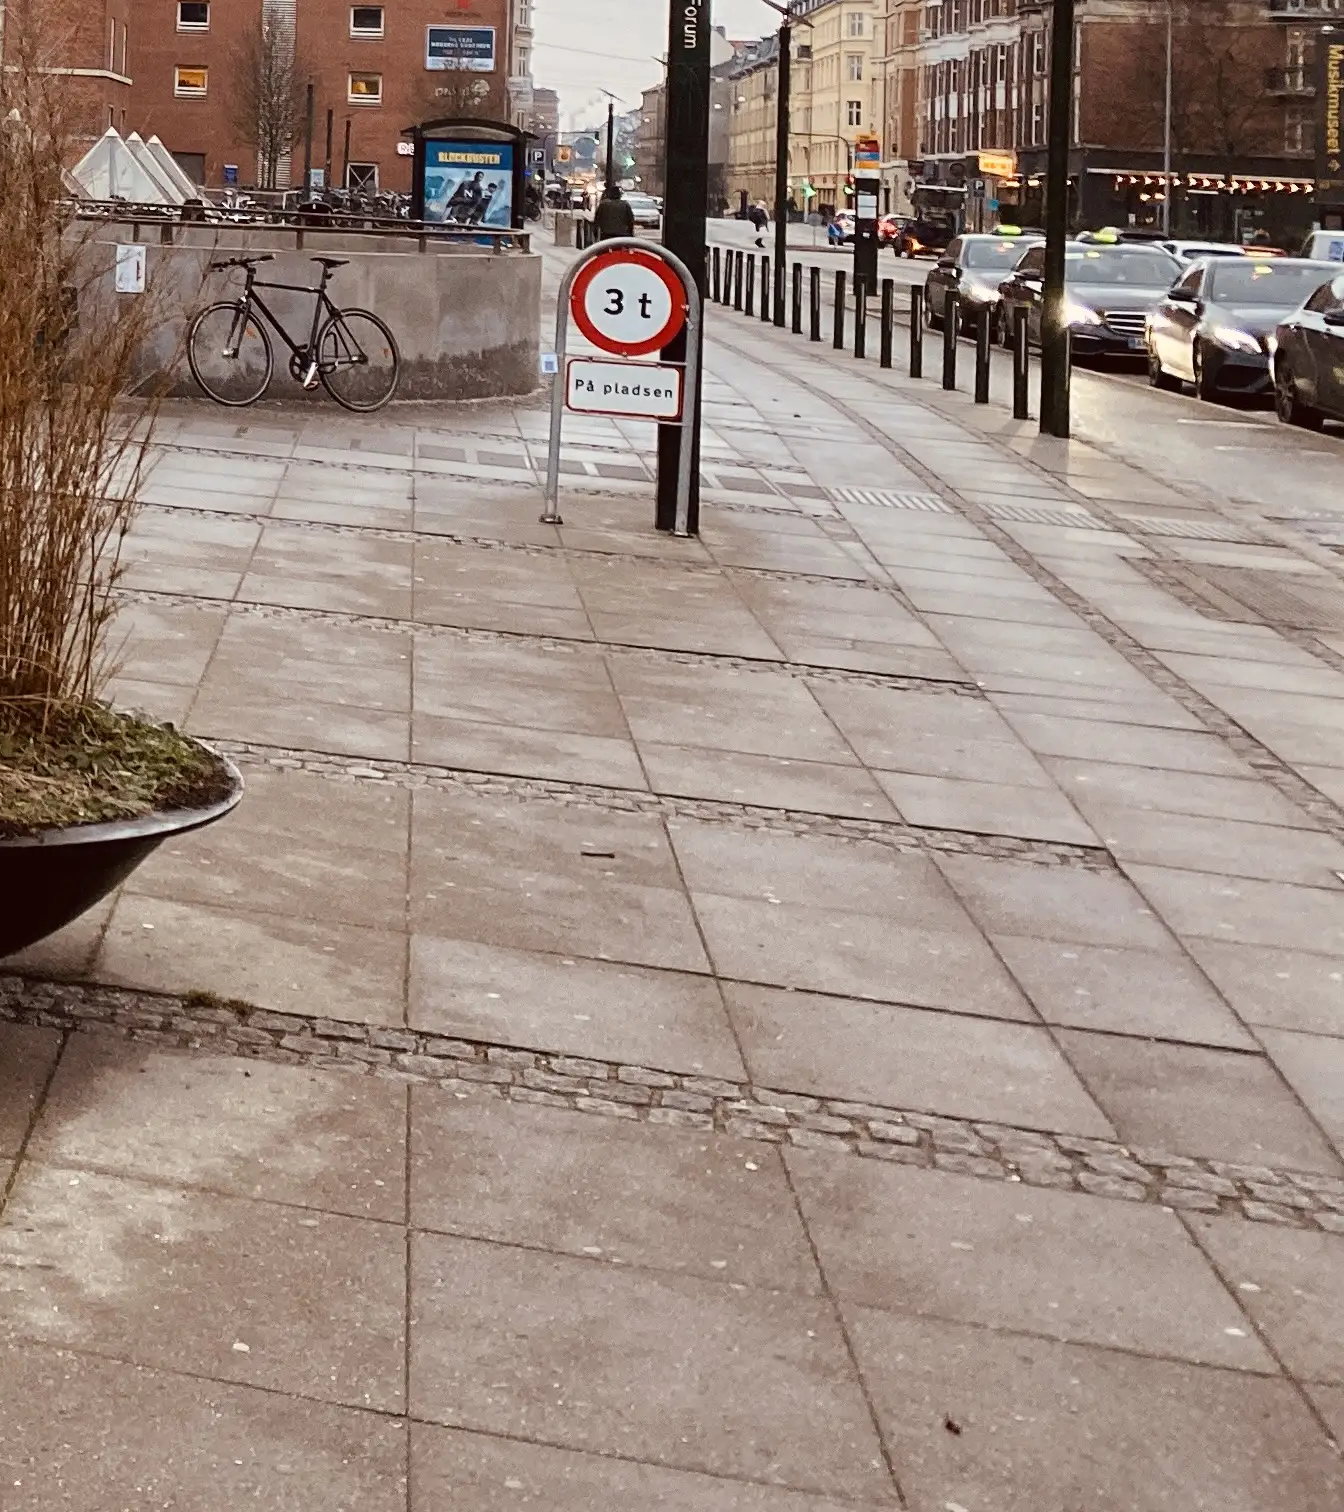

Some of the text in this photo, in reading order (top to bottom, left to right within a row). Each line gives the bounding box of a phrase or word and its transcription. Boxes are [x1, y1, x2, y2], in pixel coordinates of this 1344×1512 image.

[1327, 44, 1344, 155] Musikmuseet
[534, 151, 543, 161] P
[976, 180, 984, 190] P
[603, 288, 652, 319] 3 t
[575, 378, 673, 399] På pladsen
